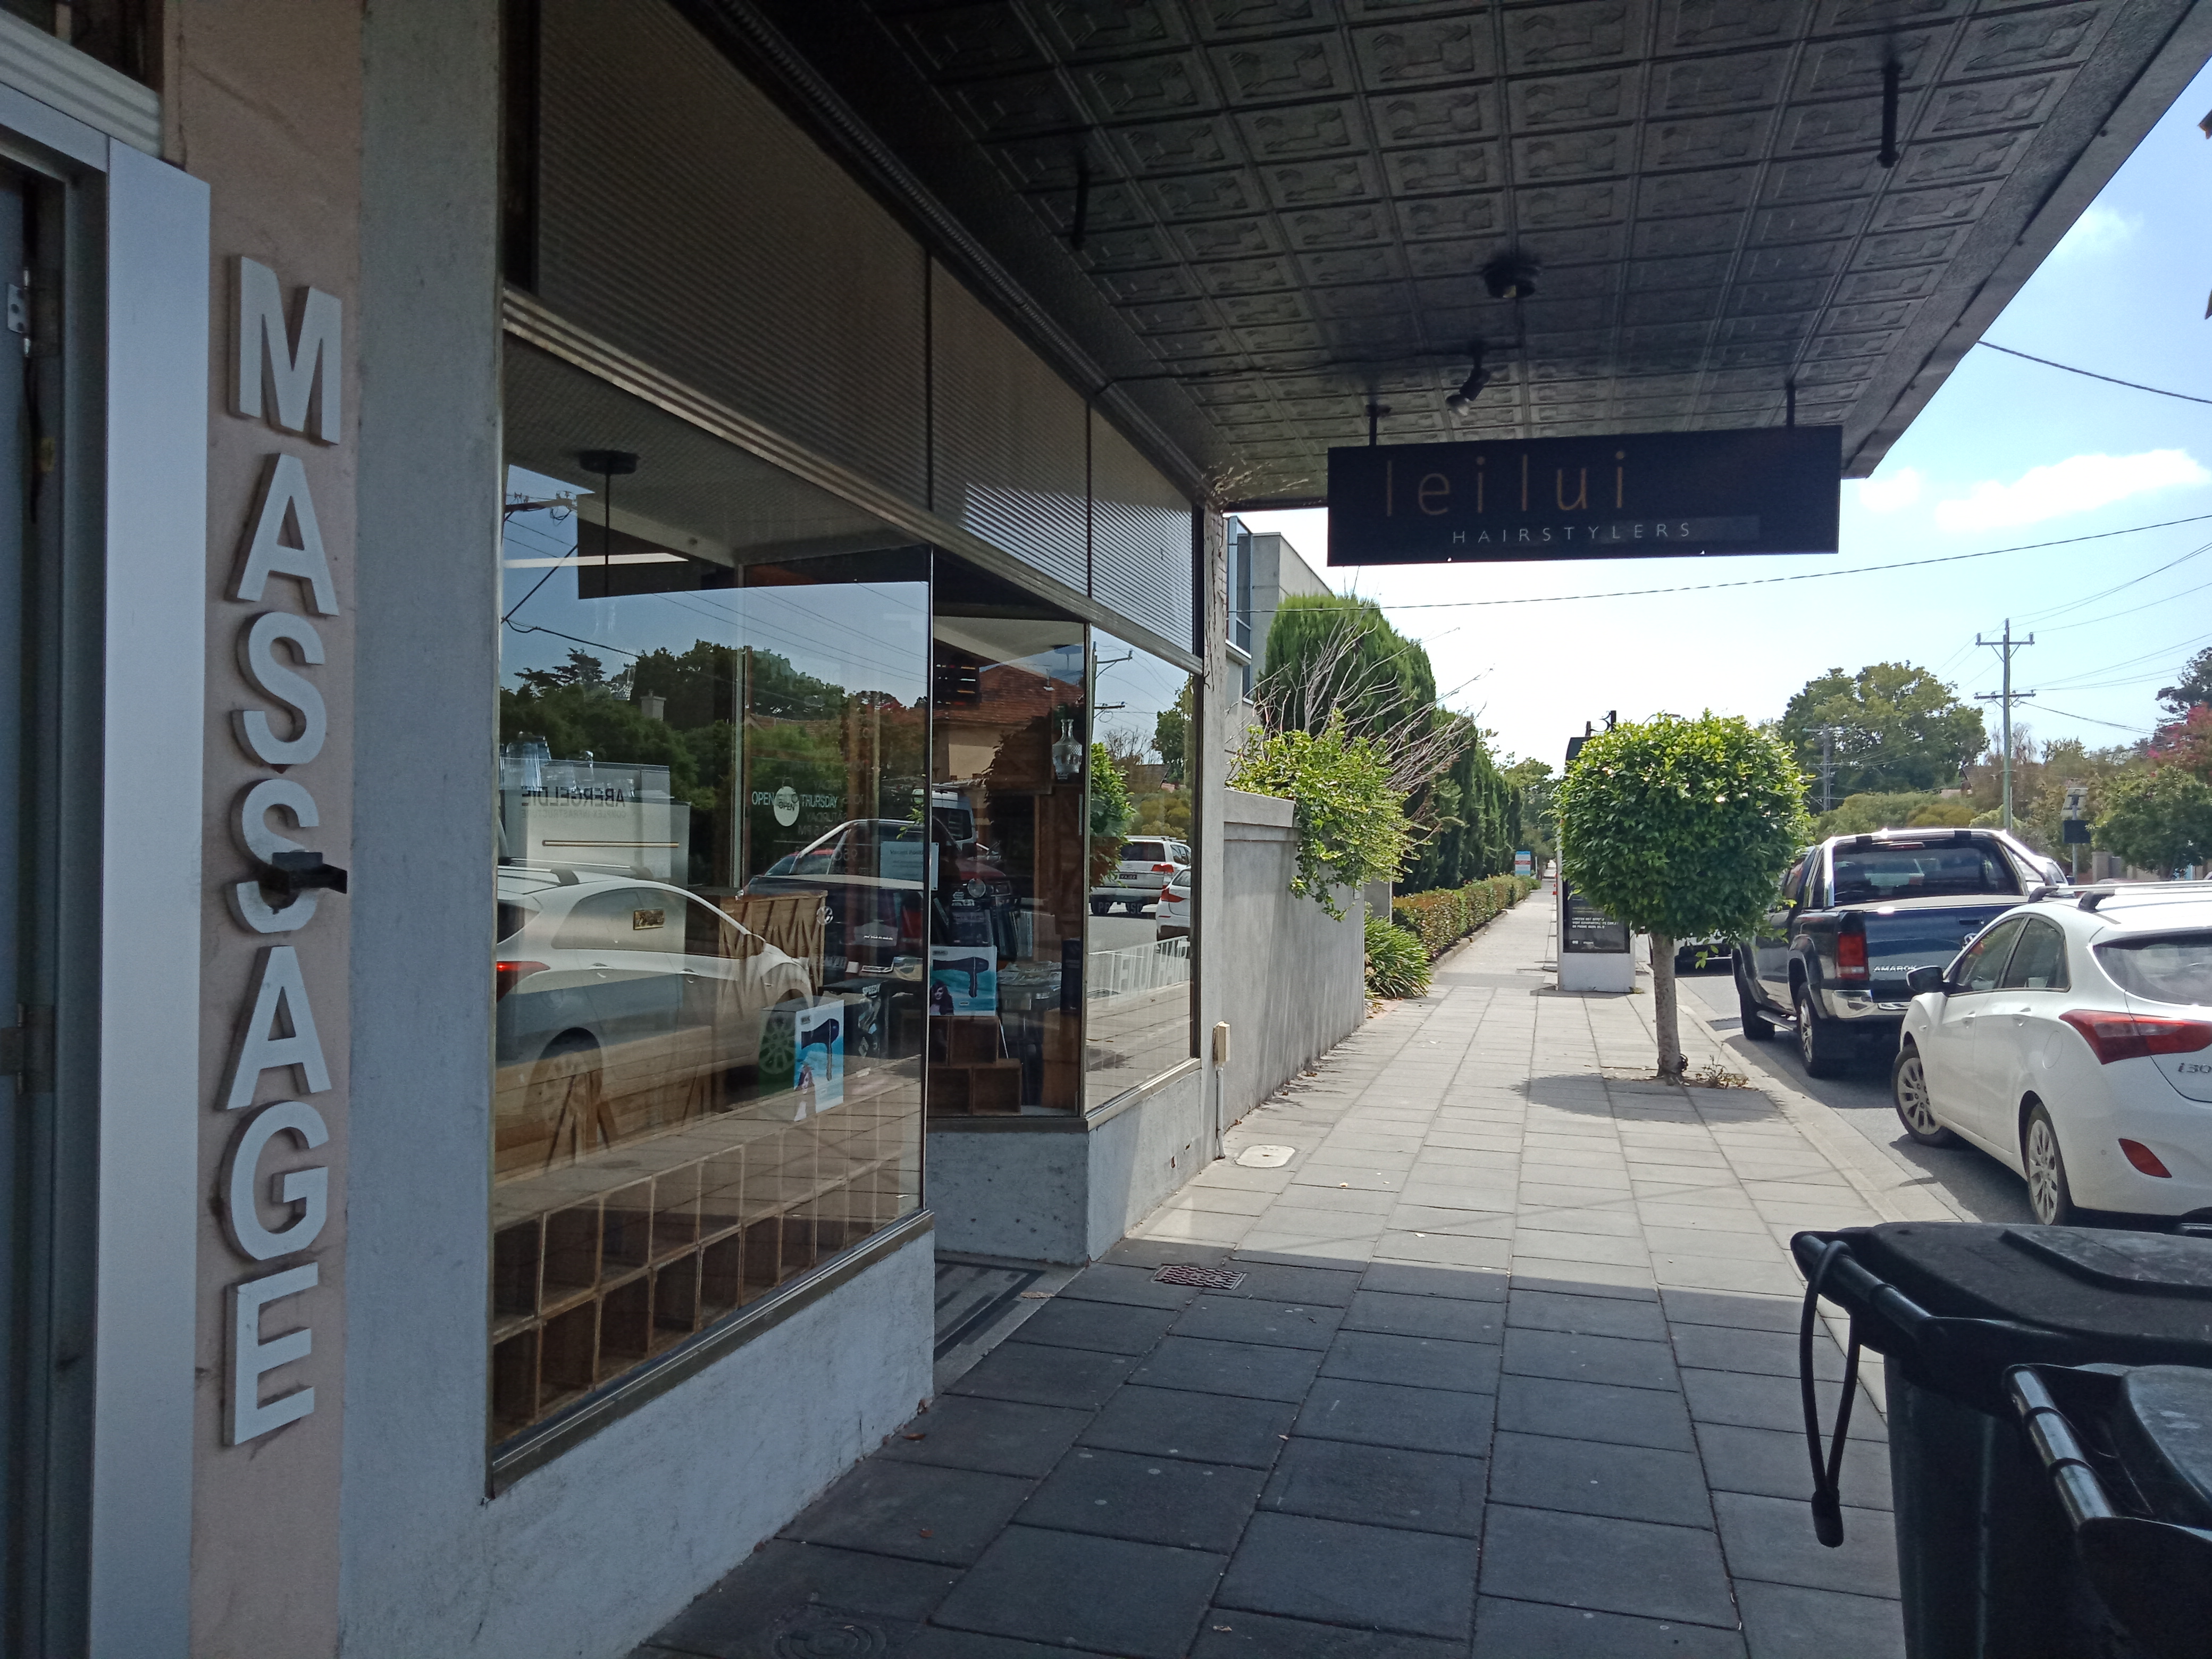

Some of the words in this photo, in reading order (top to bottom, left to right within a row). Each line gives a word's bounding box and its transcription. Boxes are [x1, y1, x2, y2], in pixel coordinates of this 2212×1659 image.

[1386, 450, 1625, 517] leilui
[1452, 522, 1690, 544] HAIRSTYLERS
[751, 791, 775, 806] OPEN
[800, 794, 839, 808] THURSDAY
[225, 256, 342, 1446] MASSAGE
[1872, 965, 1917, 973] AMAROK
[2177, 1062, 2212, 1074] i30
